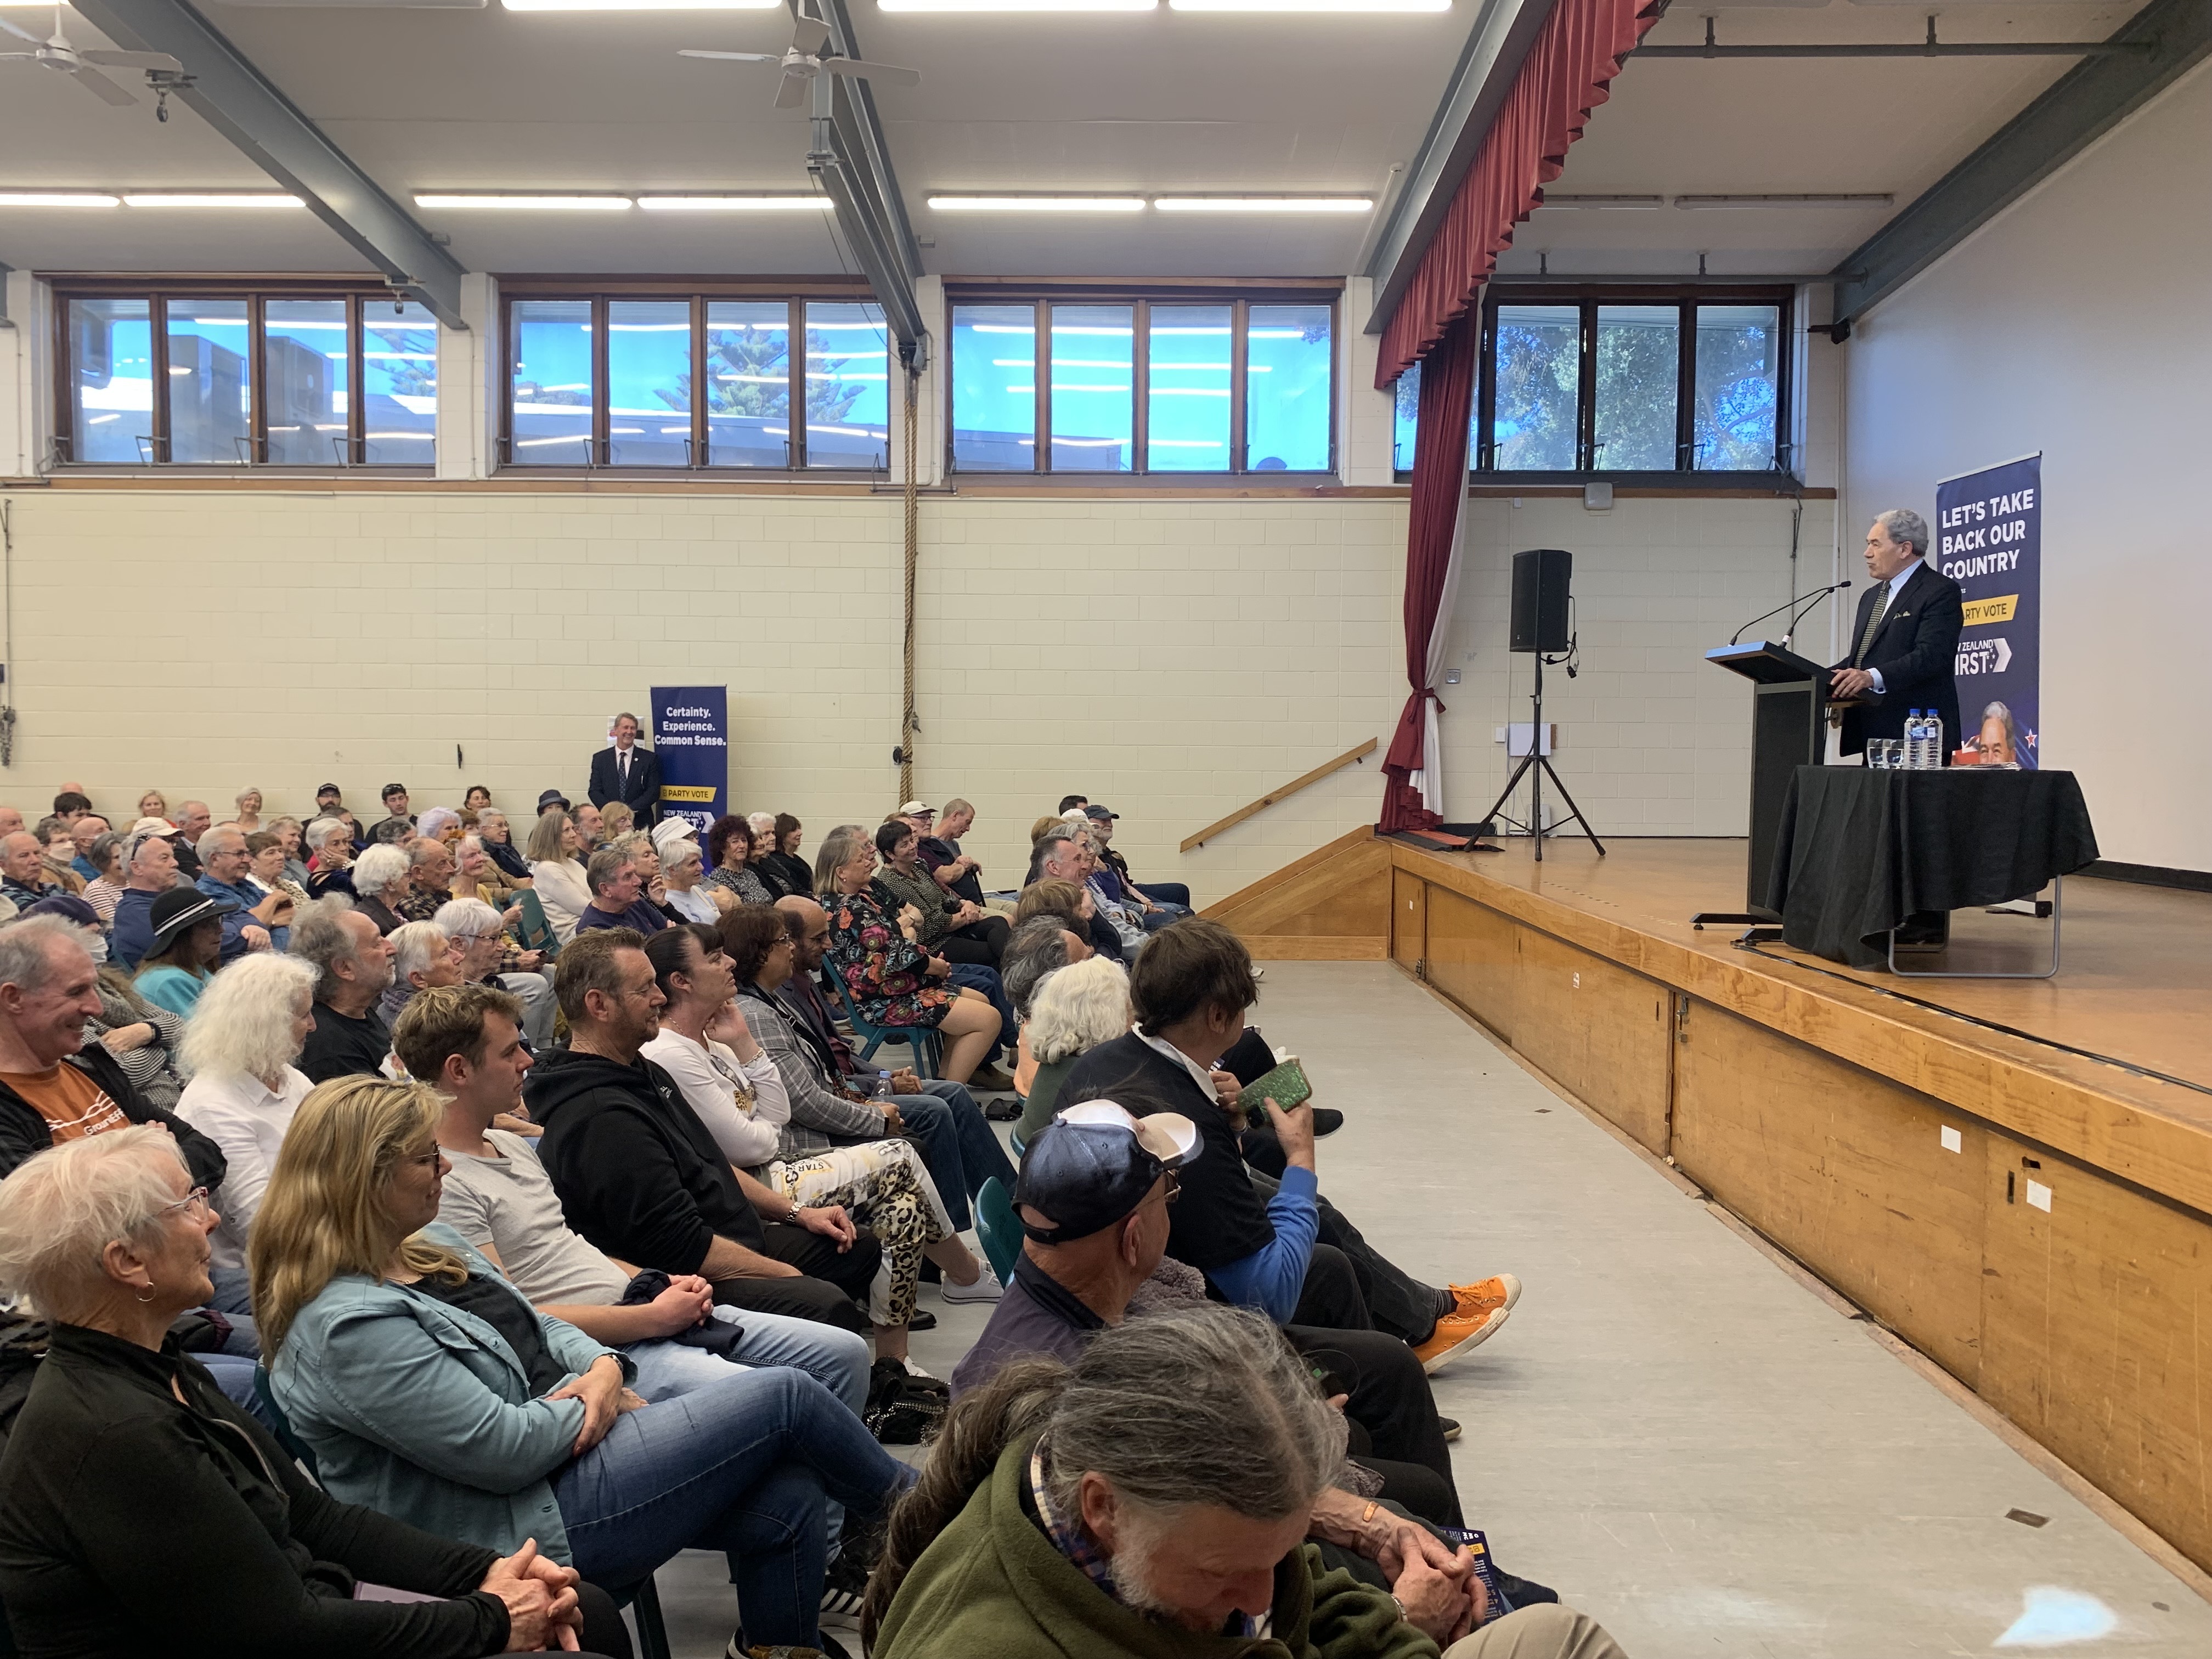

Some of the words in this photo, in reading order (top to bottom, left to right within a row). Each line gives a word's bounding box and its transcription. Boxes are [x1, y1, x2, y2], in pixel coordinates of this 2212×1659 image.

[1942, 501, 1986, 529] LET'S
[1989, 488, 2034, 517] TAKE
[1942, 528, 1986, 555] BACK
[1990, 520, 2026, 545] OUR
[1942, 549, 2020, 579] COUNTRY
[1963, 607, 1980, 620] RTY
[1983, 603, 2007, 617] VOTE
[1962, 639, 1994, 652] ZEALAND
[1955, 651, 1990, 676] IRST
[666, 706, 712, 719] Certainty.
[662, 720, 716, 733] Experience.
[654, 734, 693, 746] Common
[694, 735, 727, 746] Sense.
[668, 789, 690, 798] PARTY
[691, 790, 709, 798] VOTE
[798, 1161, 824, 1172] STAR
